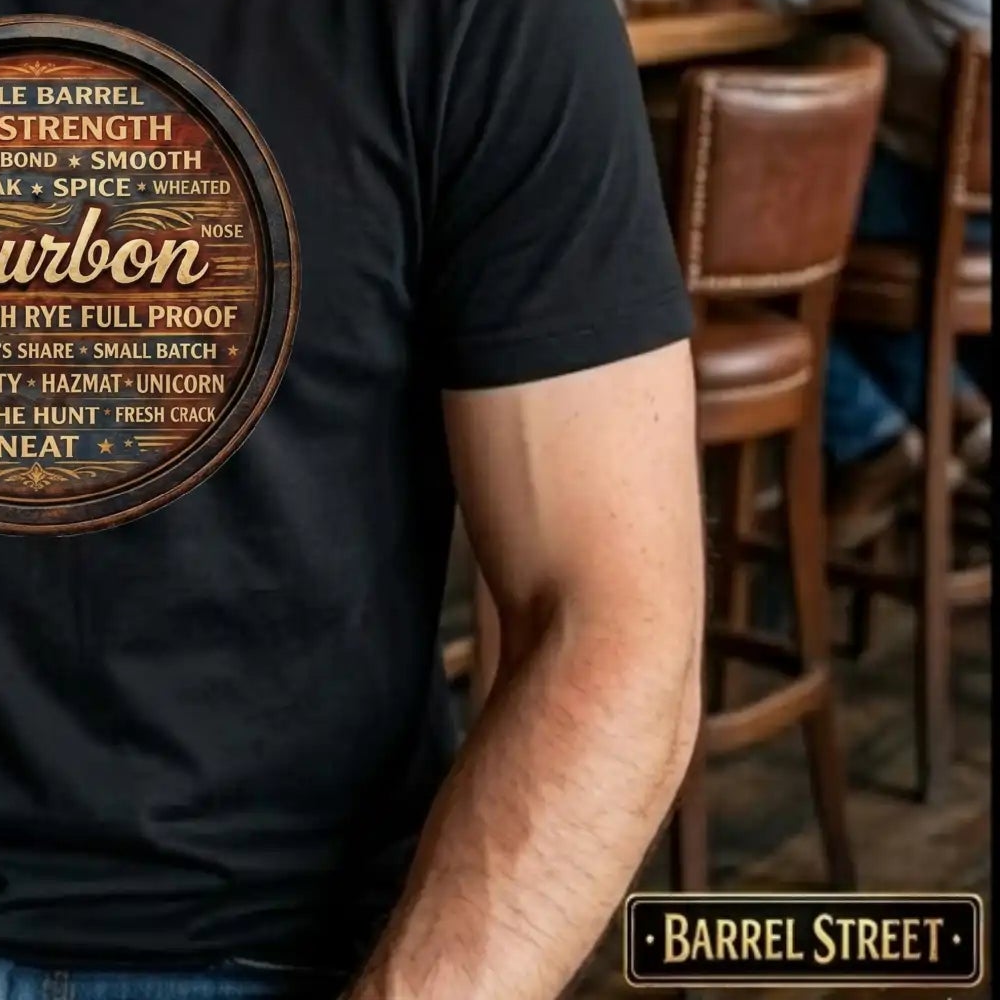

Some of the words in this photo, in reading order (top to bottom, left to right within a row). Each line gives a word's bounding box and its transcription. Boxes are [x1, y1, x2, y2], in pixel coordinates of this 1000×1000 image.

[37, 86, 144, 106] BARREL
[0, 115, 172, 141] STRENGTH
[91, 150, 201, 170] SMOOTH
[53, 178, 131, 197] SPICE
[152, 180, 230, 196] WHEATED
[200, 224, 243, 239] NOSE
[25, 306, 72, 328] RYE
[81, 305, 142, 328] FULL
[148, 306, 238, 328] PROOF
[17, 343, 74, 359] SHARE
[93, 343, 151, 359] SMALL
[156, 343, 217, 359] BATCH
[41, 373, 122, 393] HAZMAT
[136, 374, 224, 393] UNICORN
[33, 406, 99, 425] HUNT
[115, 406, 165, 423] FRESH
[170, 406, 216, 423] CRACK
